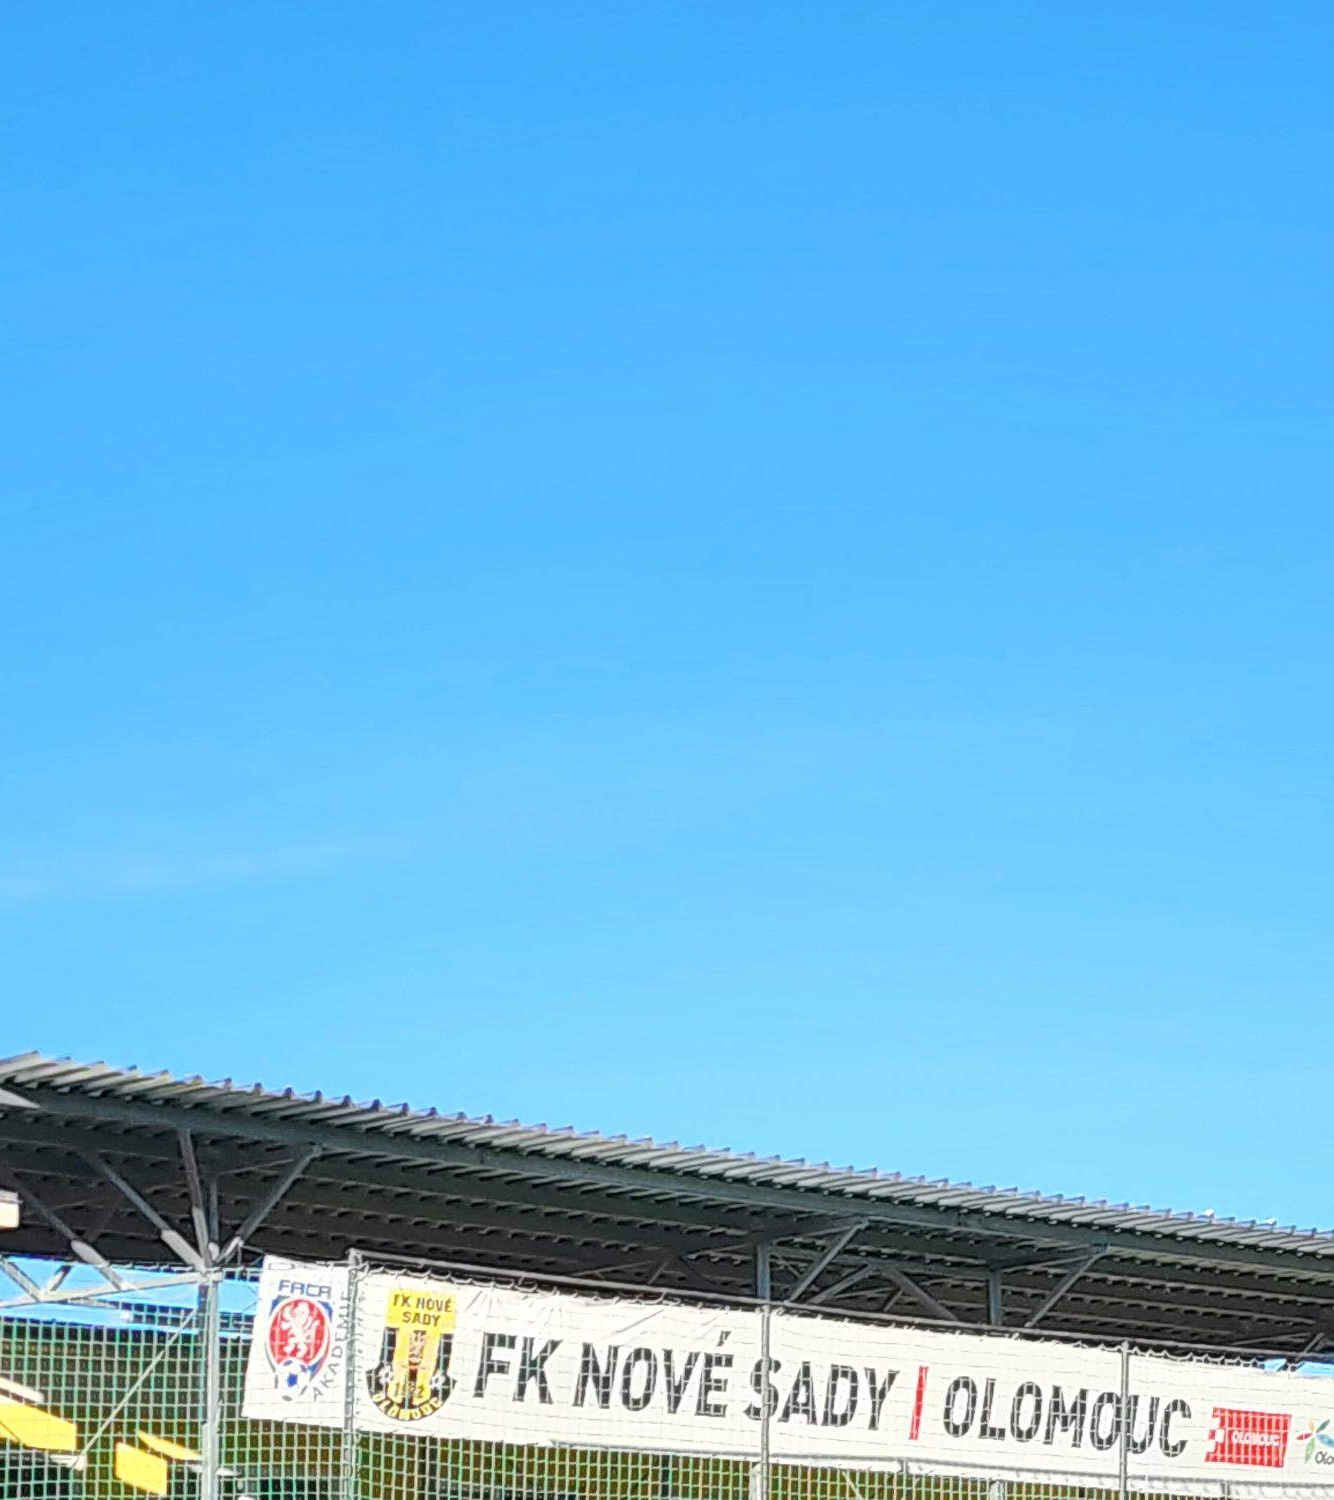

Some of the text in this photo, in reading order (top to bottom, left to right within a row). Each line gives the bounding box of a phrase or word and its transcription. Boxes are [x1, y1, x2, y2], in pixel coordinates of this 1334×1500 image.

[416, 1296, 453, 1313] NOVÉ
[402, 1311, 441, 1328] SADY
[474, 1331, 1193, 1459] FK NOVÉ SADY OLOMOUC
[1231, 1430, 1281, 1448] OLOMOUC
